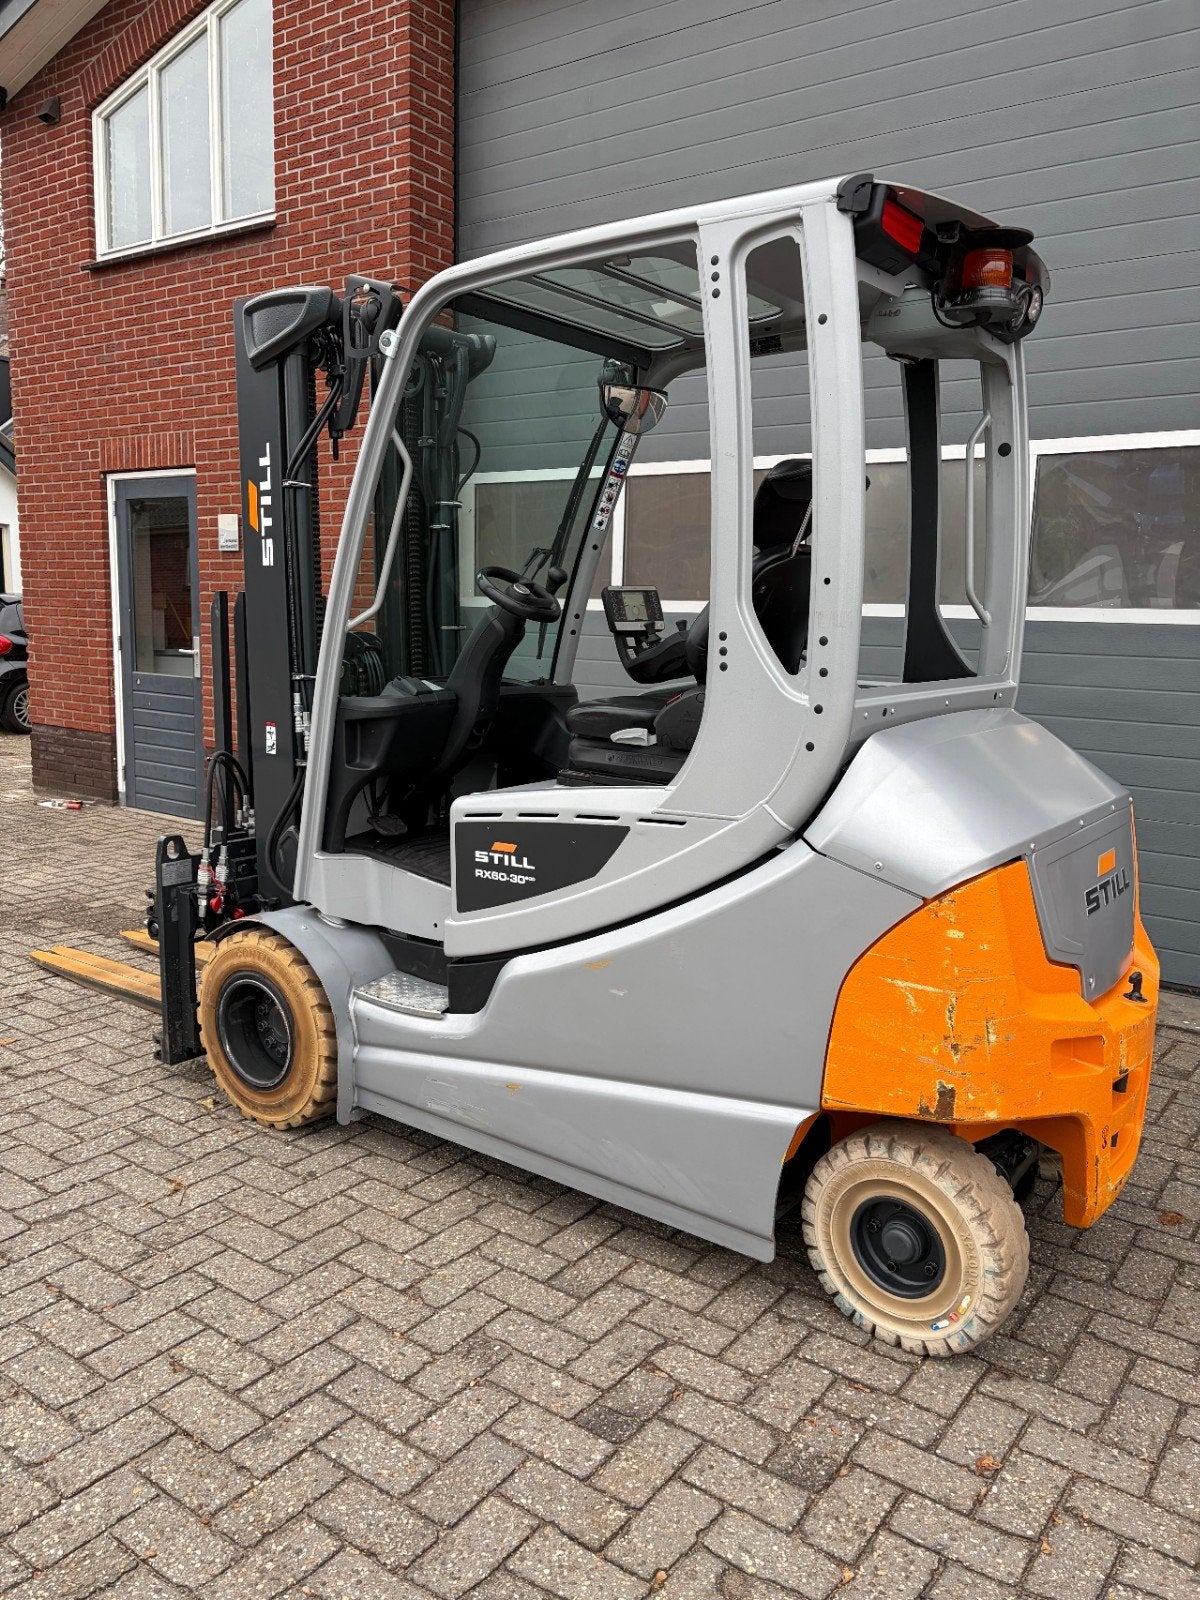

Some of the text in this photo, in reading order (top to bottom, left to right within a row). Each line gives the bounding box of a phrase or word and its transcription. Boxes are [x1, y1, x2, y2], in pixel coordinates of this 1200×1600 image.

[259, 442, 273, 566] STILL
[475, 851, 535, 869] STILL
[1084, 867, 1130, 917] STILL
